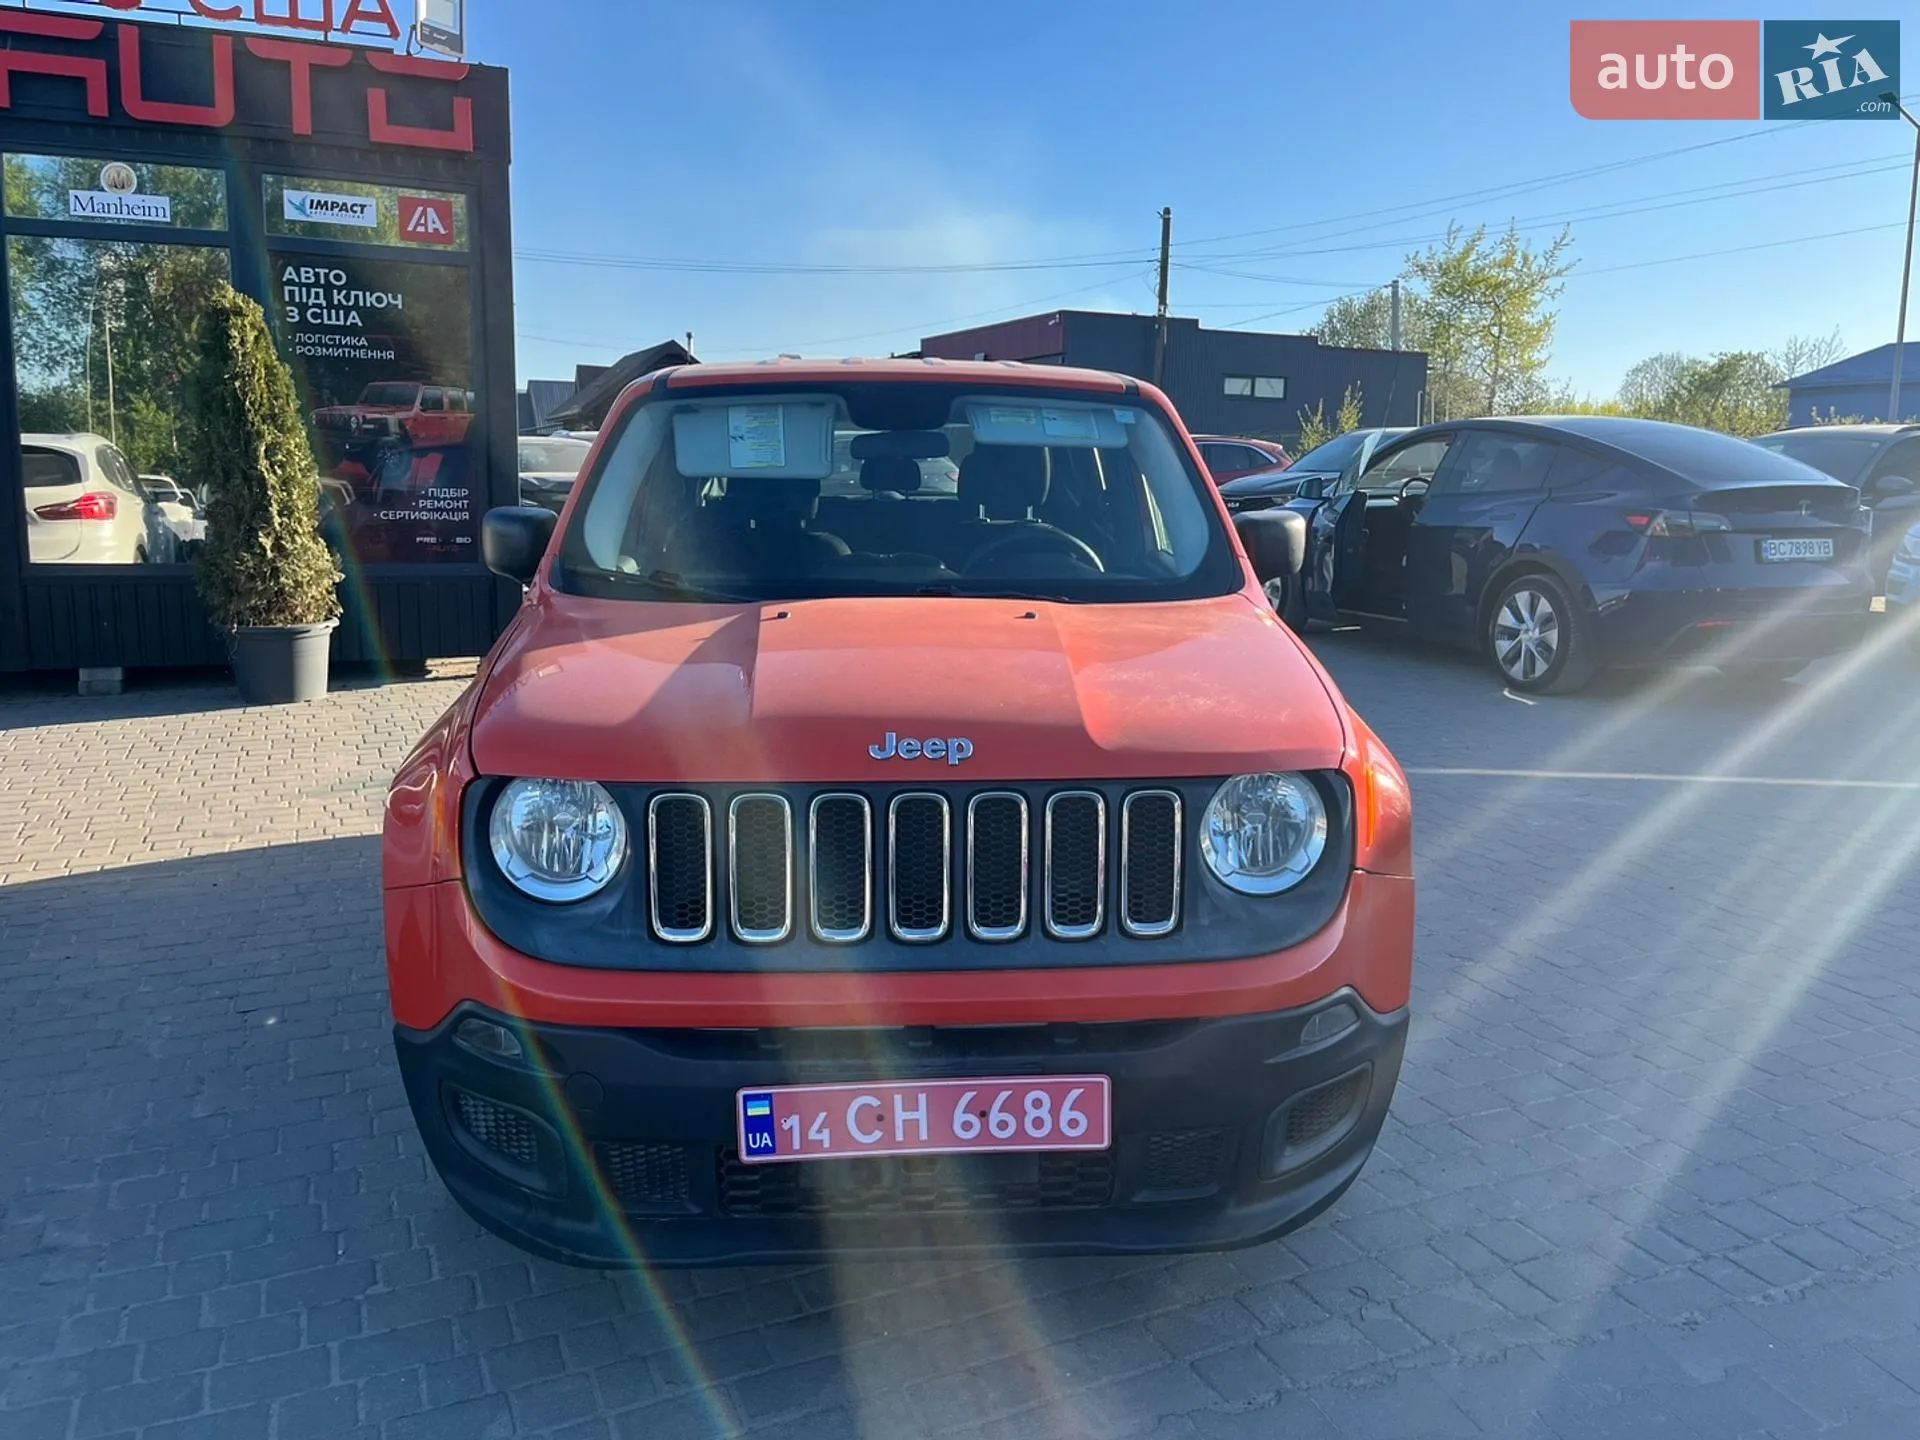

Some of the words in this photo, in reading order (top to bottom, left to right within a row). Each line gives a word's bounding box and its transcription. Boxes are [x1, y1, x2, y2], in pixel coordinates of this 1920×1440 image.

[72, 194, 169, 219] Manheim
[309, 198, 368, 215] IMPACT
[282, 266, 347, 286] АВТО
[283, 286, 327, 307] ПІД
[332, 289, 403, 310] КЛЮЧ
[306, 308, 363, 327] США
[295, 333, 369, 347] ЛОГІСТИКА
[296, 346, 396, 360] РОЗМИТНЕННЯ
[427, 488, 469, 499] ПІДБІР
[418, 500, 469, 509] РЕМОНТ
[380, 511, 469, 522] СЕРТИФІКАЦІЯ
[868, 731, 974, 766] Jeep
[781, 1112, 830, 1150] 14
[845, 1093, 928, 1144] CH
[952, 1088, 1088, 1139] 6686
[748, 1133, 772, 1149] UA
